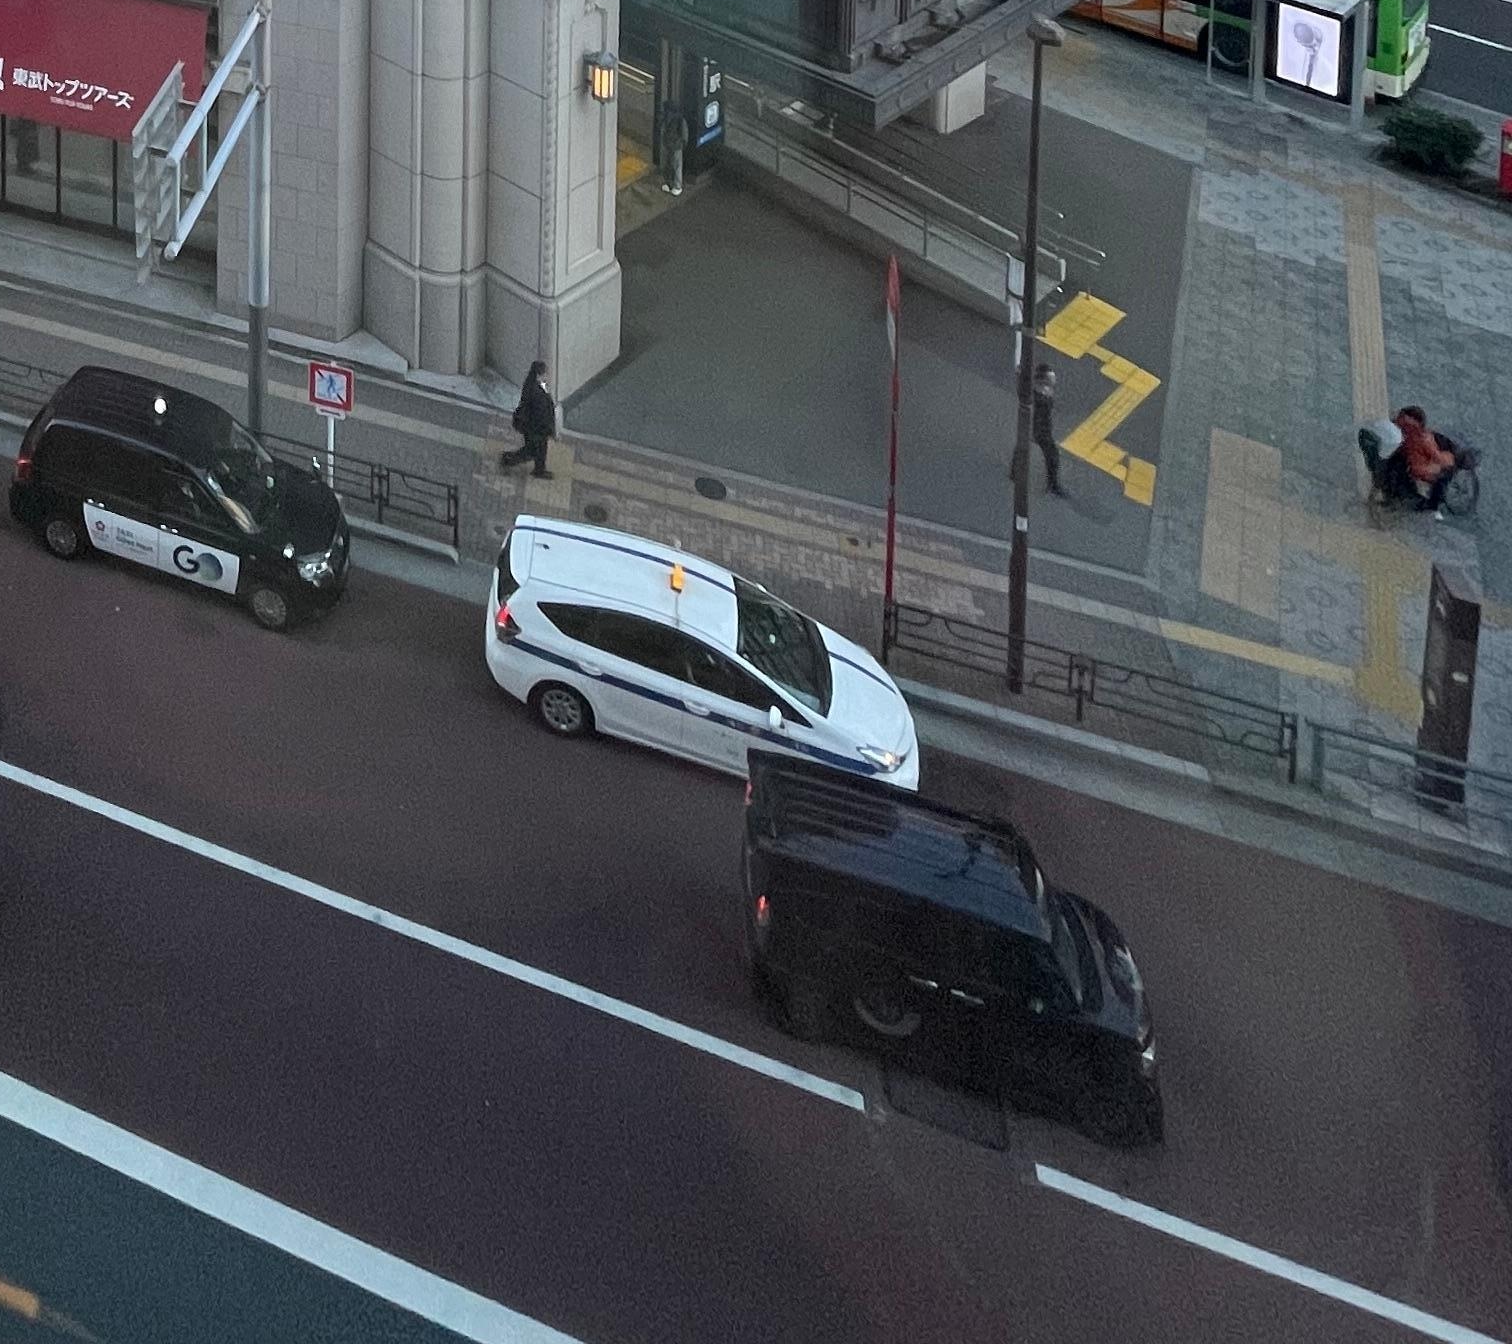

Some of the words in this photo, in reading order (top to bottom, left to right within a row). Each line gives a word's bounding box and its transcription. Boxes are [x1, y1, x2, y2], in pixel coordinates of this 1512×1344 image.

[12, 67, 135, 109] 東武トップツアーズ
[172, 544, 224, 582] GO
